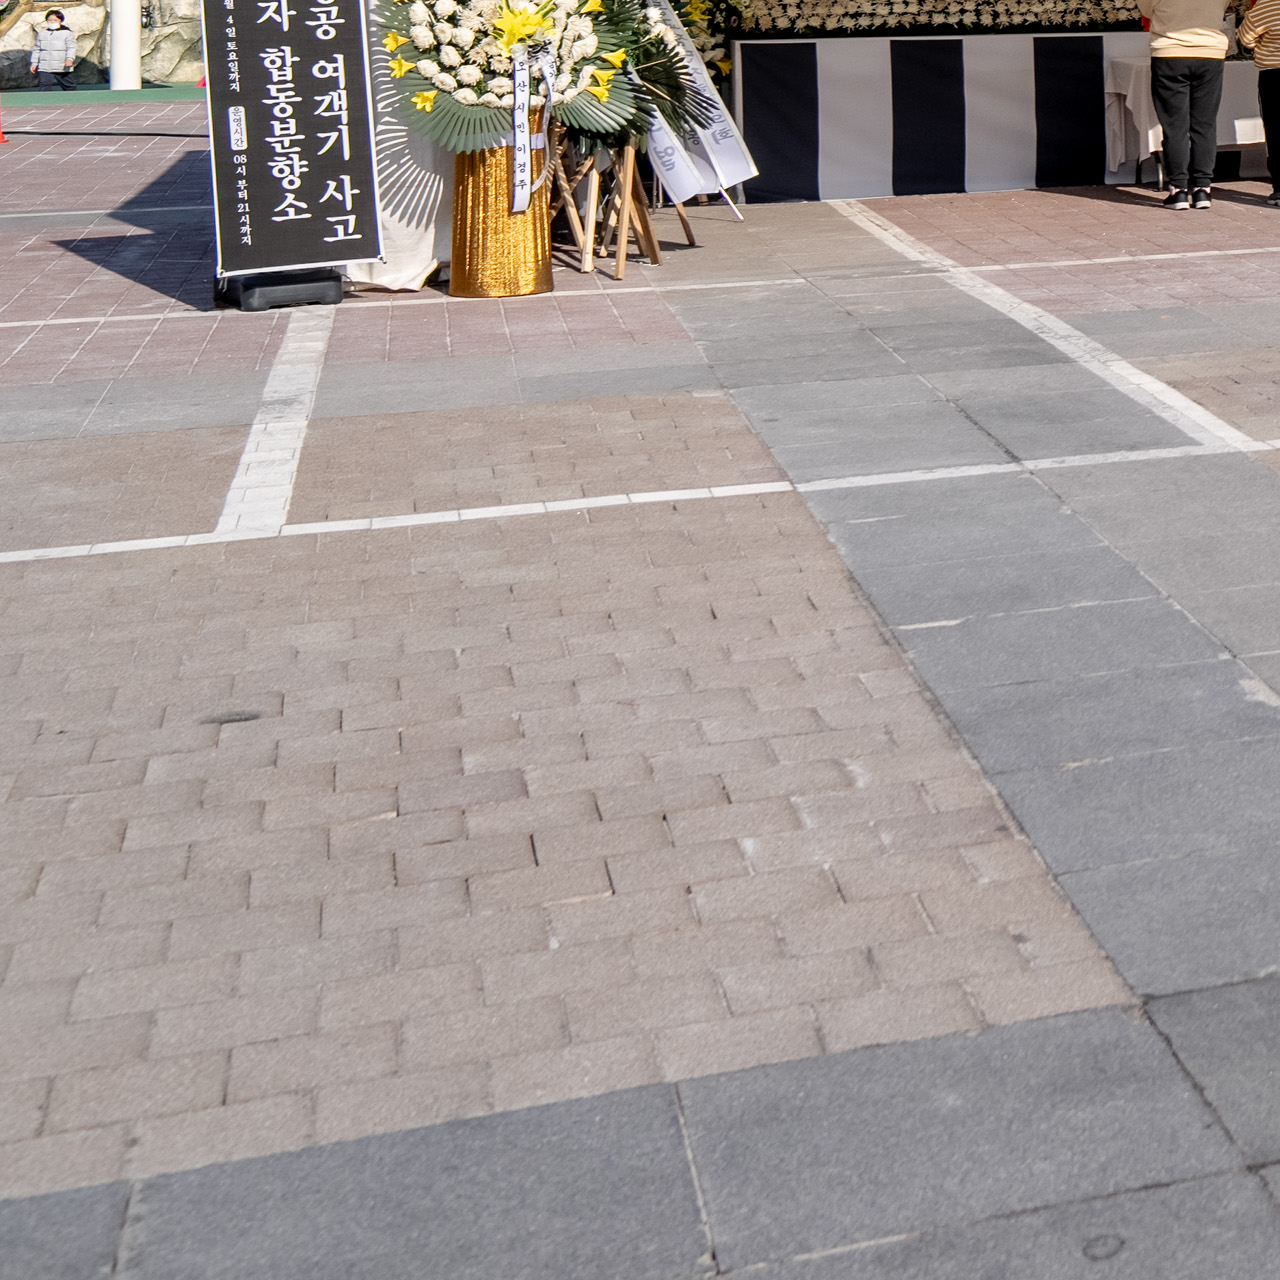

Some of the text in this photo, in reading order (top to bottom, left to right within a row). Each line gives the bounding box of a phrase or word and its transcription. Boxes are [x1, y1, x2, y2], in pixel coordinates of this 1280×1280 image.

[232, 106, 245, 148] 운영시간
[259, 46, 312, 222] 합동분향소
[312, 54, 350, 161] 여객기
[319, 175, 362, 242] 사고
